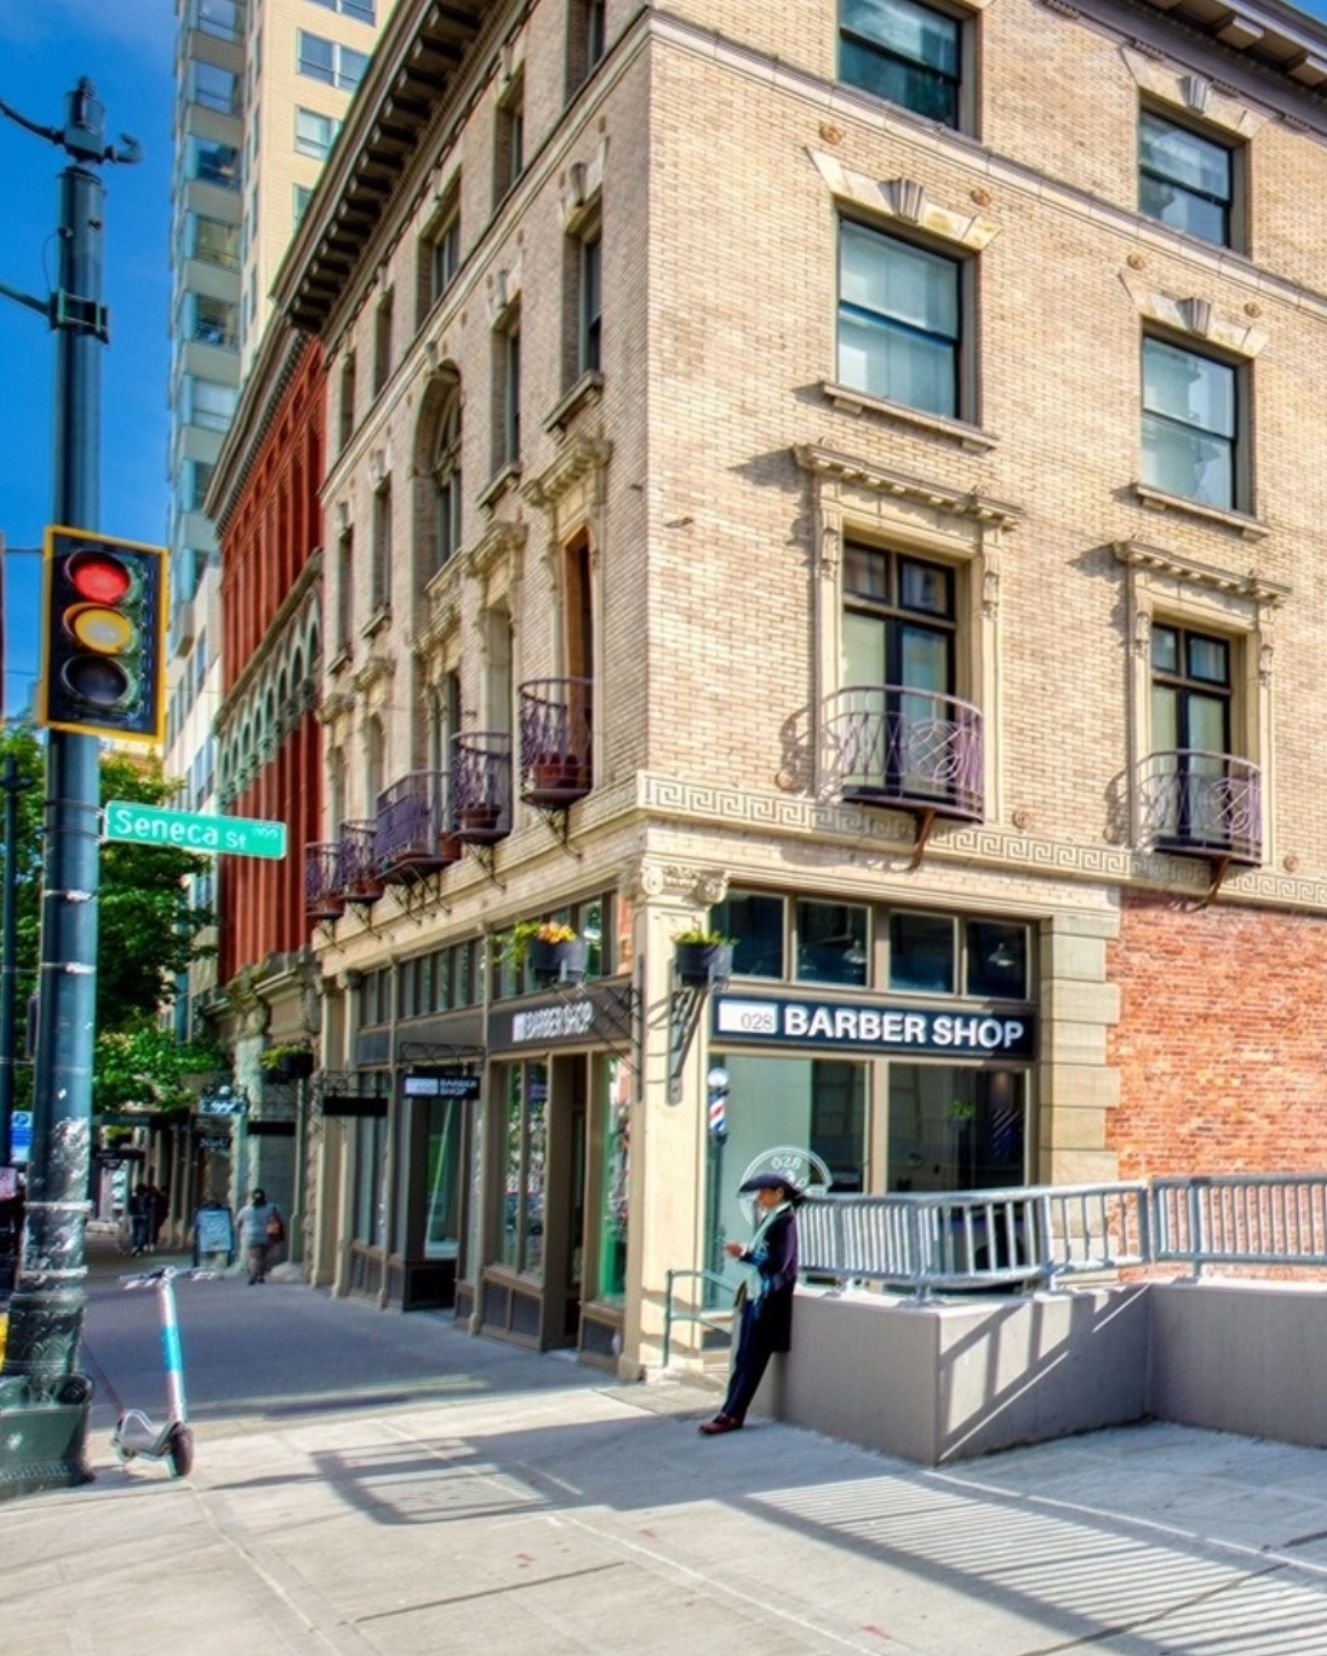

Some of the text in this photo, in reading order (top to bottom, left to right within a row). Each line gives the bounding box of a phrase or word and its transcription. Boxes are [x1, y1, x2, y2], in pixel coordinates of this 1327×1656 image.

[115, 809, 219, 846] Seneca
[226, 831, 246, 849] St
[740, 1004, 1025, 1049] 028 BARBER SHOP
